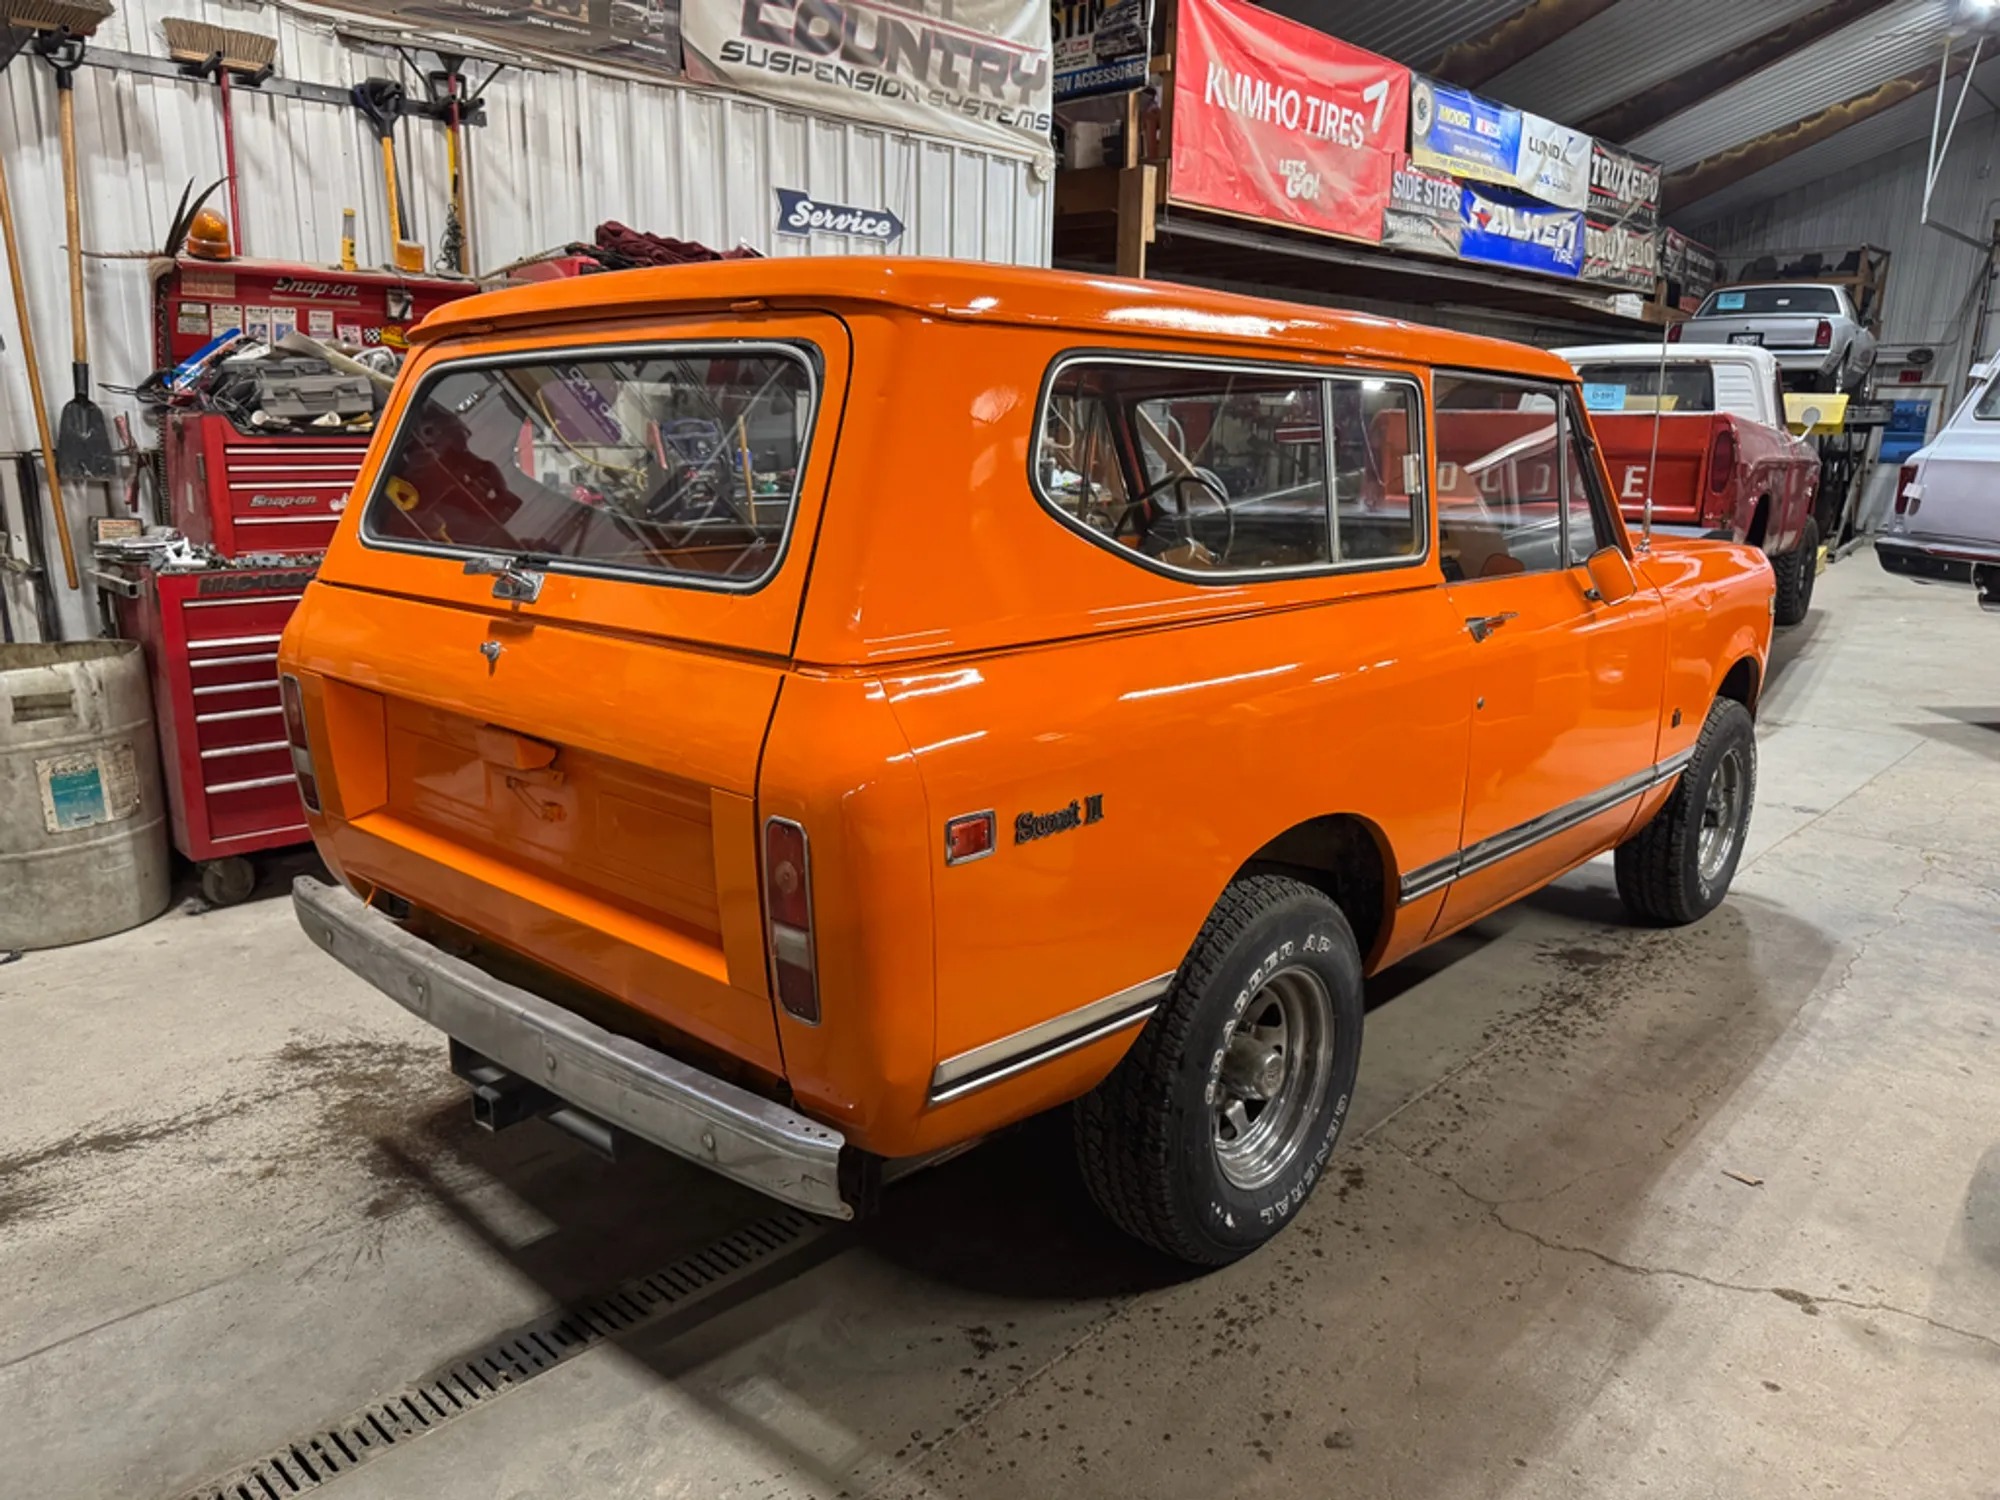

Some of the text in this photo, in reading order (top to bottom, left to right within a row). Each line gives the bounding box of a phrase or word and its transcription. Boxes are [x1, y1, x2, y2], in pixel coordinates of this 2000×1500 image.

[740, 0, 1048, 106] COUNTRY
[719, 40, 1051, 131] SUSPENSION SYSTEMS
[1204, 61, 1365, 150] KUMHO TIRES
[1279, 159, 1306, 177] LET'S
[1286, 173, 1321, 200] GO!
[1393, 170, 1422, 202] SIDE
[1424, 179, 1461, 212] STEPS
[788, 200, 891, 236] Service
[272, 276, 359, 298] Snap-on
[249, 494, 318, 508] Snap-on
[1014, 793, 1104, 846] Scout II
